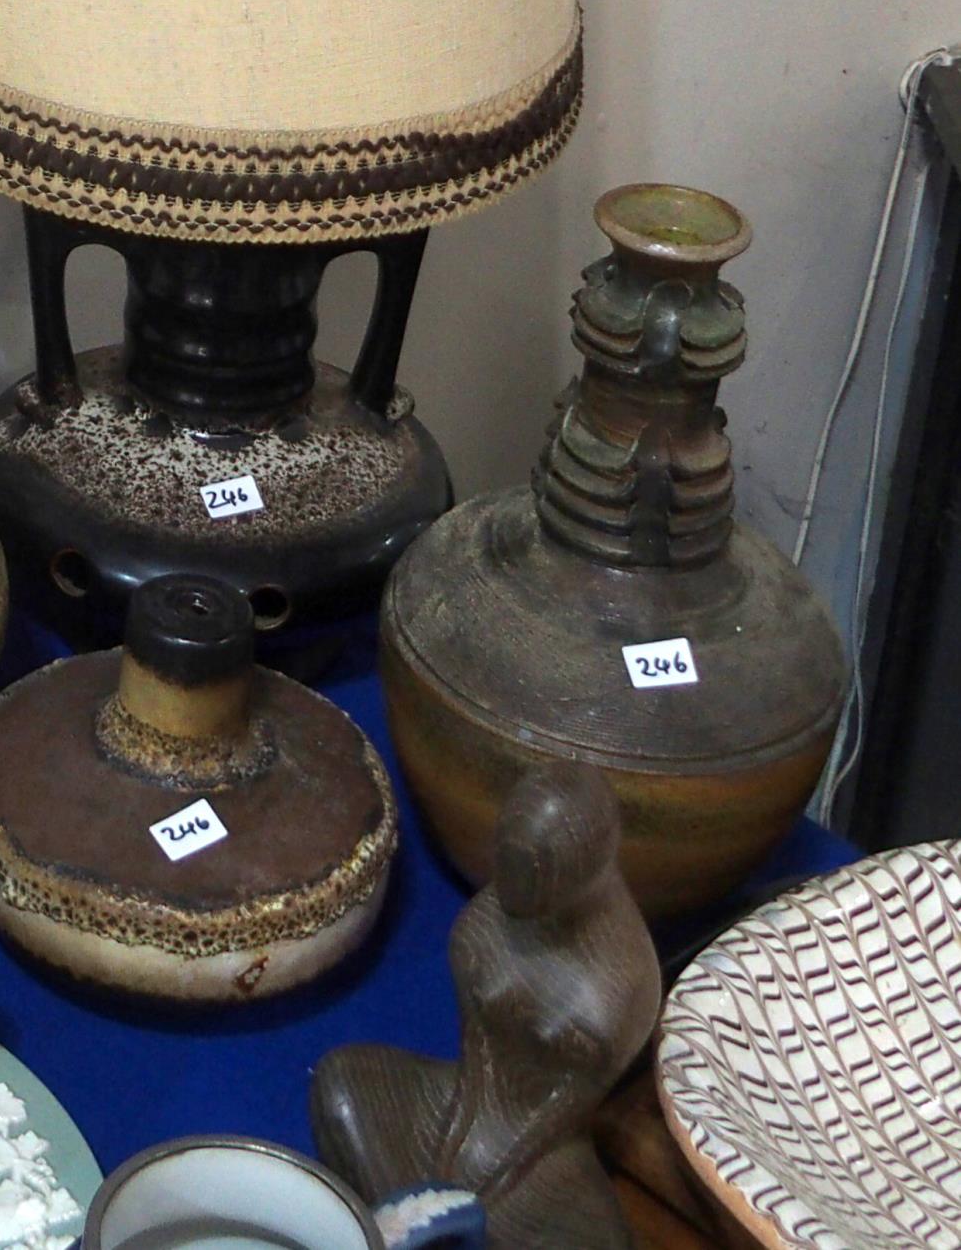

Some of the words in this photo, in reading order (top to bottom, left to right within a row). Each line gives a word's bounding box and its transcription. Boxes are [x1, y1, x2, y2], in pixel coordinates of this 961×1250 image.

[205, 487, 248, 509] 246
[635, 651, 687, 677] 246
[160, 816, 210, 841] 246
